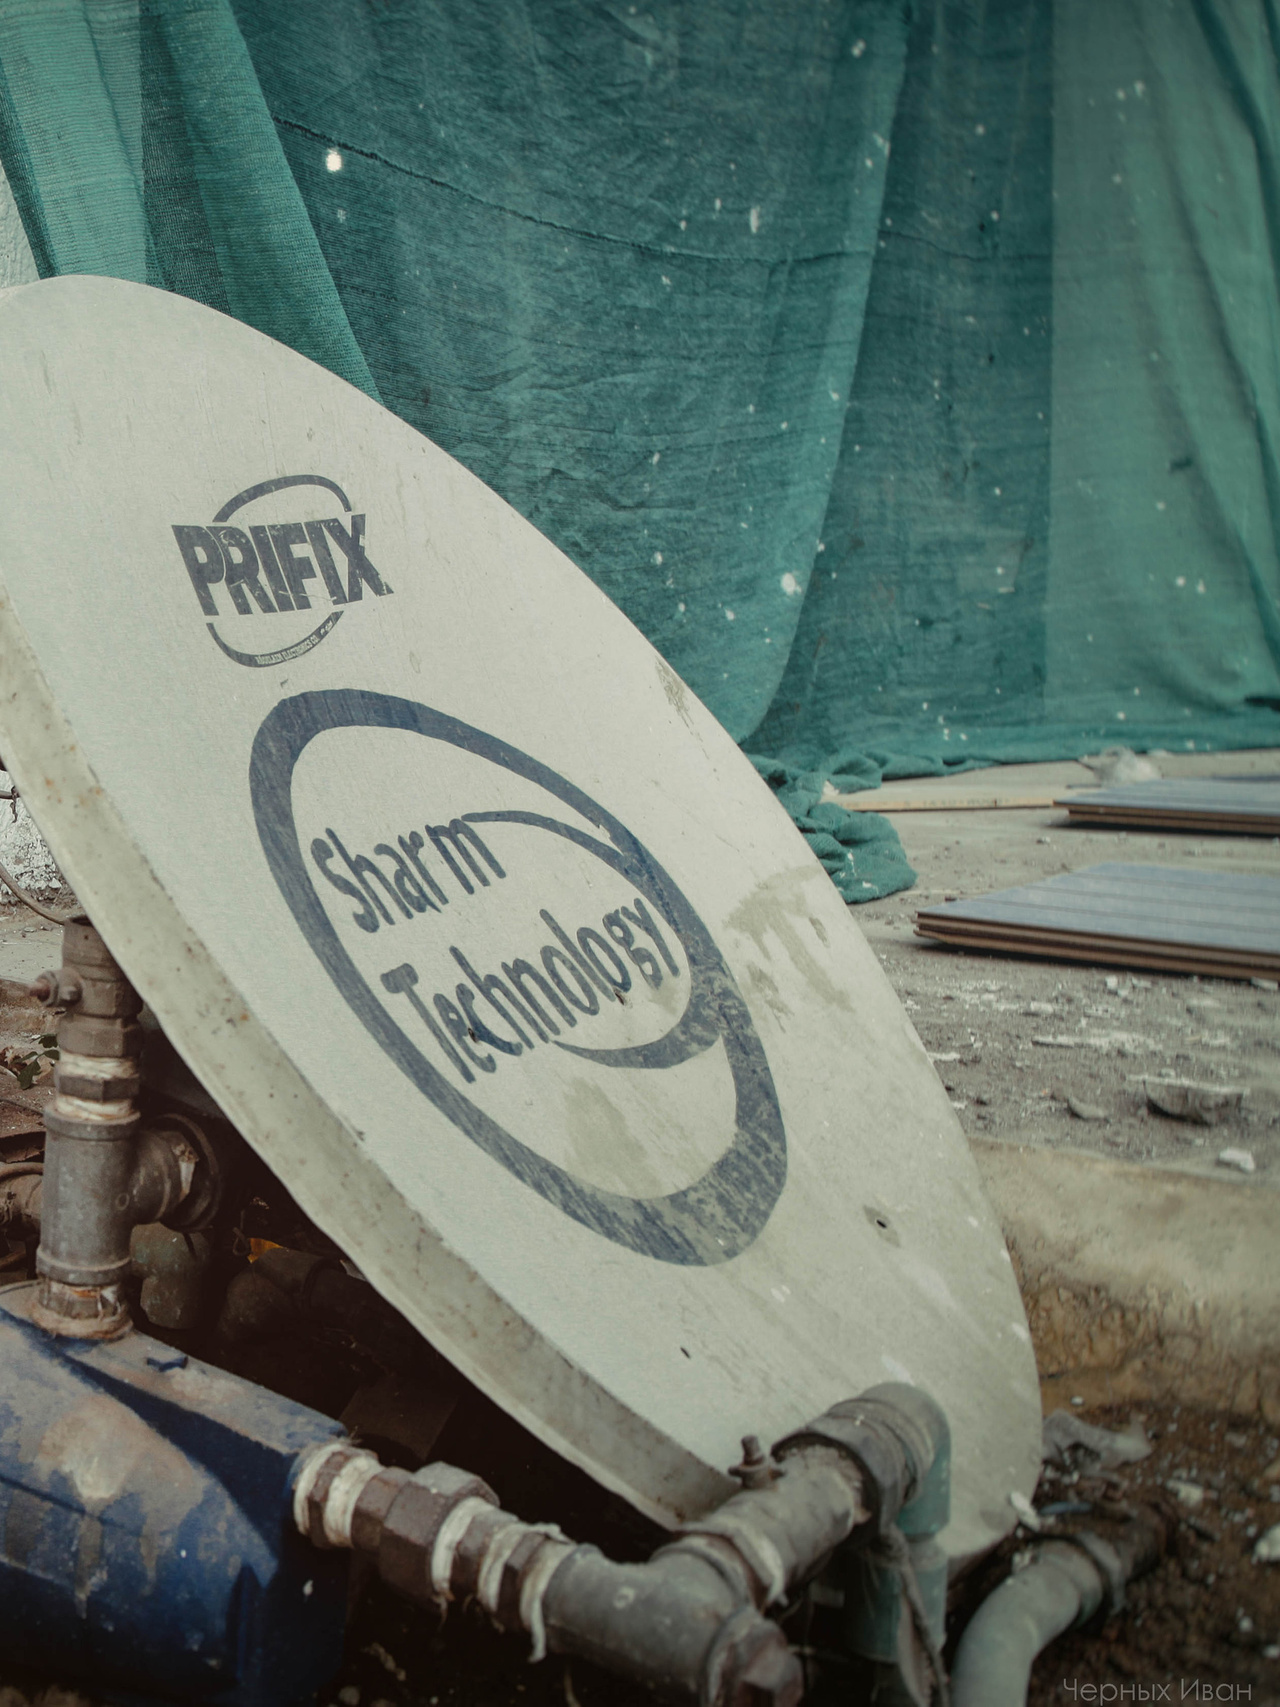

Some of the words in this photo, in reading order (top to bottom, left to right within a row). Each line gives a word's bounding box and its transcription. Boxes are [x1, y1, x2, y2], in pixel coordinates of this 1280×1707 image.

[171, 514, 394, 616] PRIFIX
[311, 817, 507, 933] Sharm
[380, 898, 680, 1084] Technology
